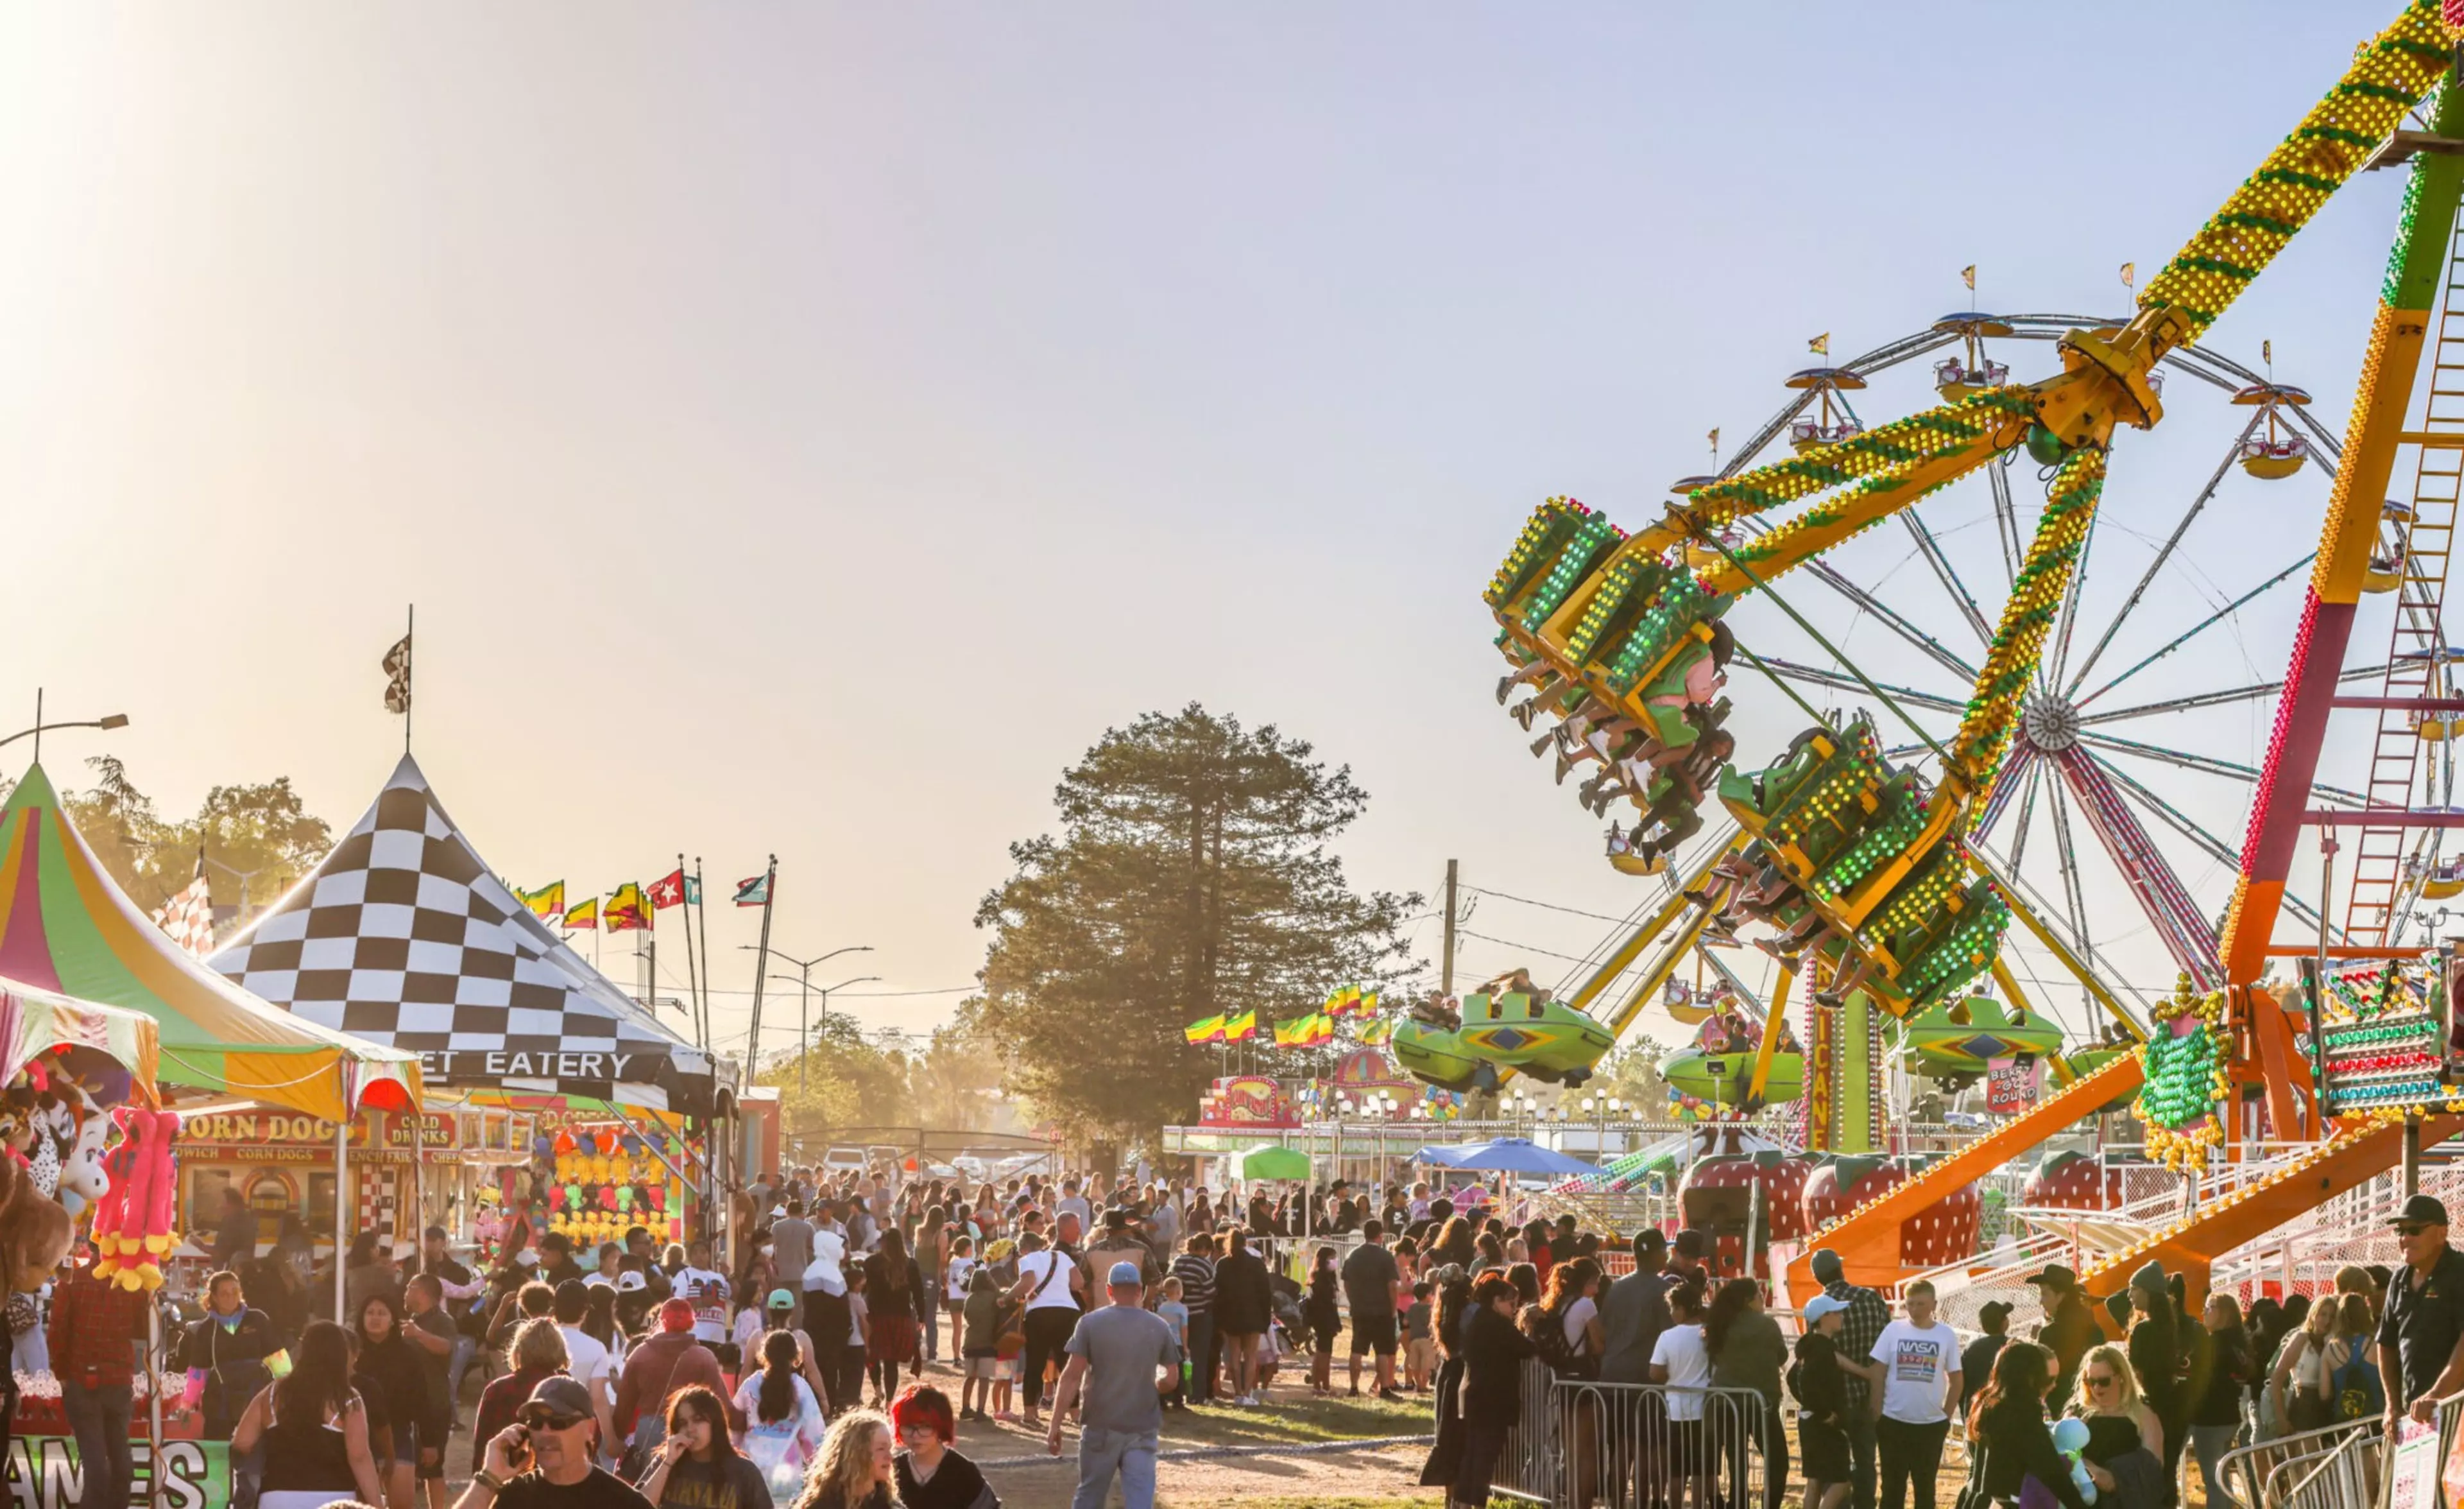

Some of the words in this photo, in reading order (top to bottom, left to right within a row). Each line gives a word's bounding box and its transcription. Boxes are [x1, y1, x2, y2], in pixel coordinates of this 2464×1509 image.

[486, 1051, 633, 1078] EATERY
[1992, 1087, 2036, 1105] ROUND
[178, 1114, 257, 1140] ORN
[236, 1148, 275, 1160] CORN
[277, 1148, 314, 1161] DOGS
[1899, 1341, 1938, 1356] NASA
